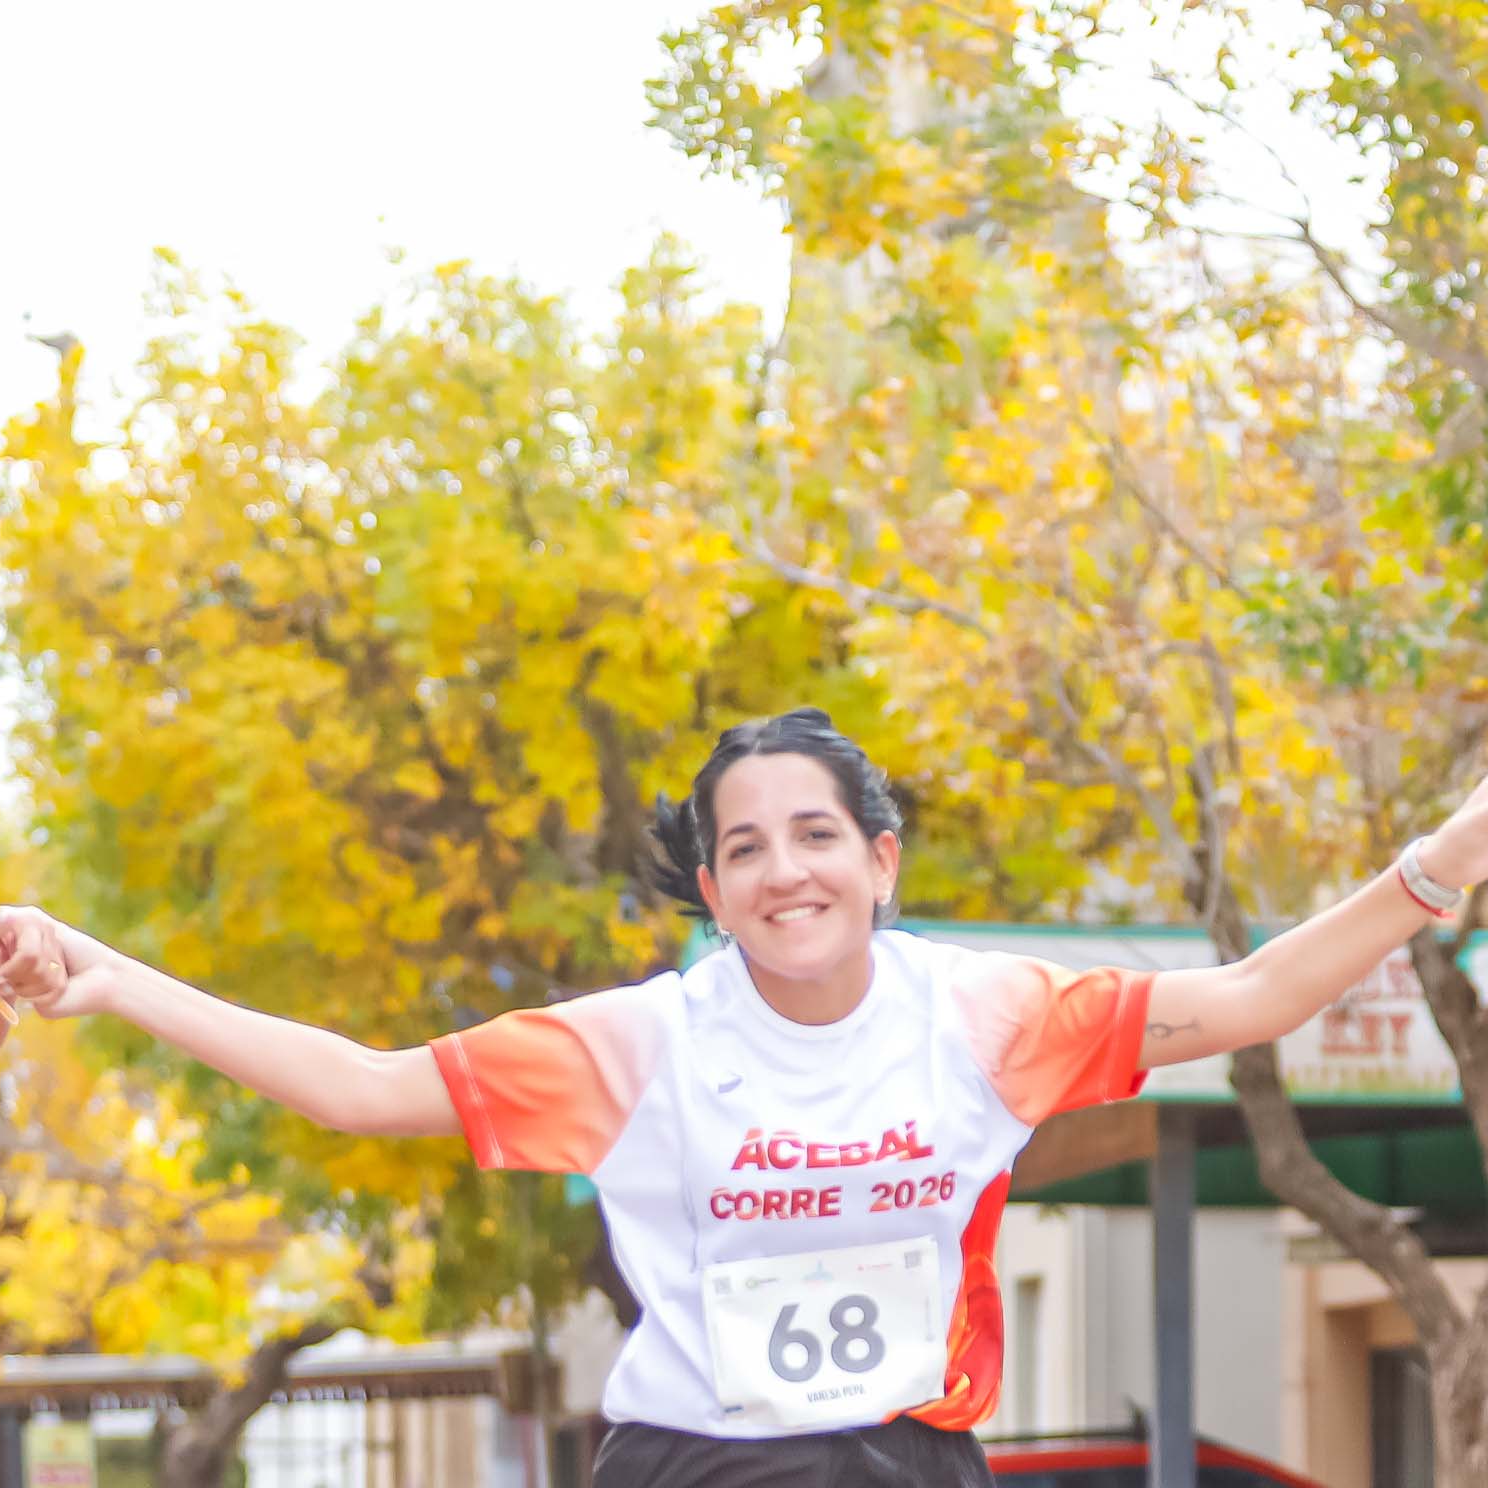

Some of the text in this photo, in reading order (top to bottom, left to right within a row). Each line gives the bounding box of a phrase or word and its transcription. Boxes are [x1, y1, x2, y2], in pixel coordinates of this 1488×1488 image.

[710, 1170, 958, 1221] CORRE 2026
[768, 1293, 887, 1383] 68
